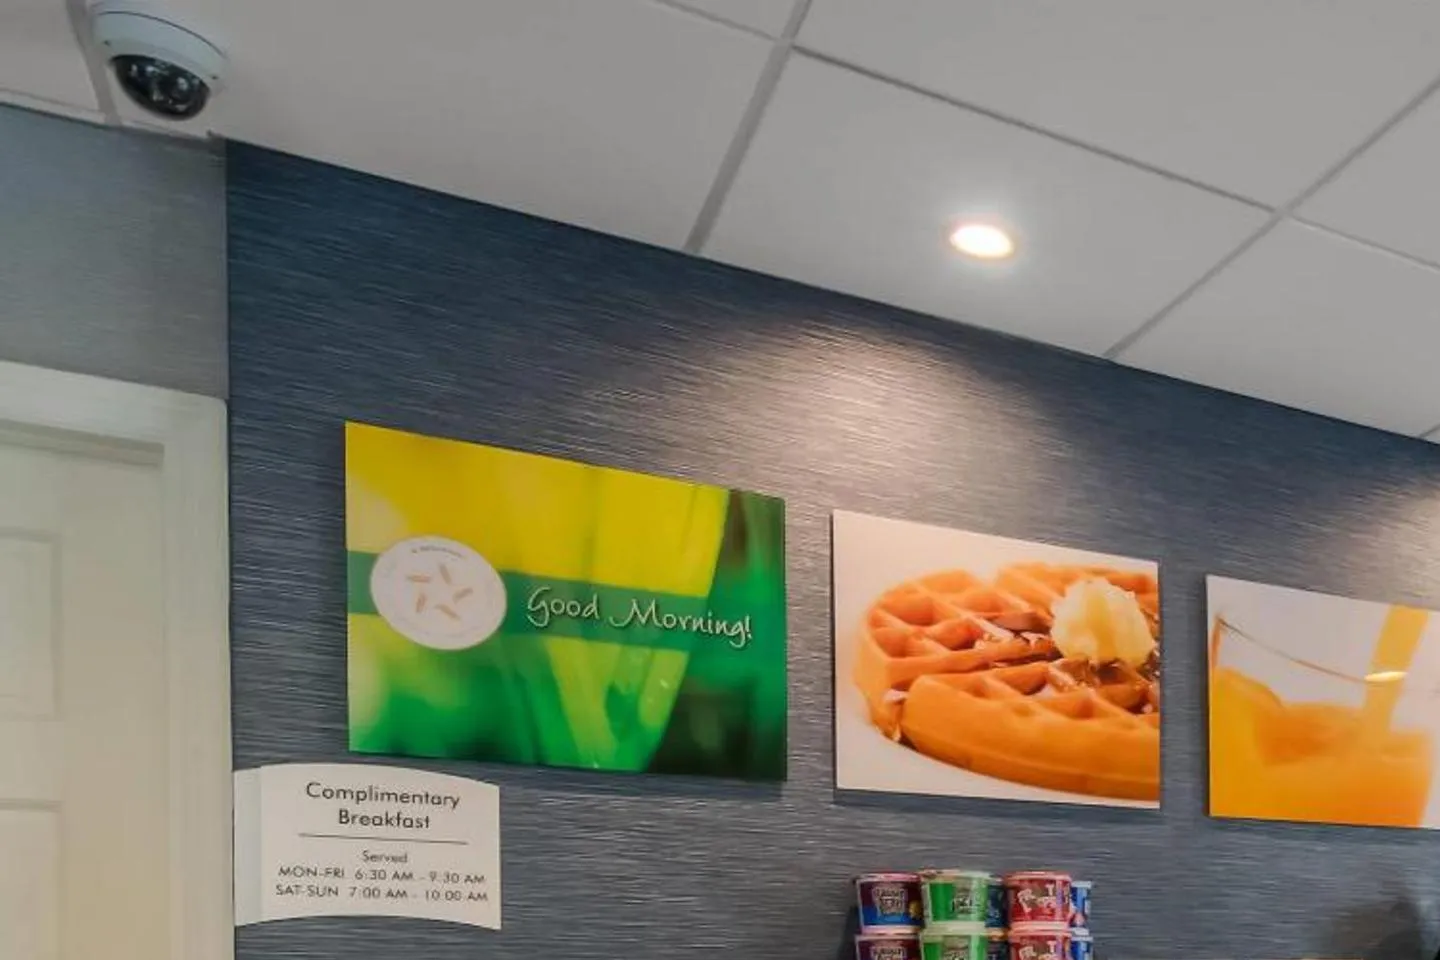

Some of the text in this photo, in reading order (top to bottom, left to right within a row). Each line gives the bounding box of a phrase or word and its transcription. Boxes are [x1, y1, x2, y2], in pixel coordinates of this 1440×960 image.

[527, 586, 752, 648] Good Morning!
[306, 782, 460, 809] Complimentary
[338, 809, 431, 829] Breakfast
[362, 850, 408, 863] Served
[278, 866, 345, 878] MON-FRI
[354, 869, 387, 881] 6:30
[392, 872, 414, 881] AM
[464, 874, 485, 884] AM
[276, 884, 339, 898] SAT-SUN
[349, 887, 381, 899] 7:00
[386, 889, 408, 899] AM
[467, 892, 488, 901] AM
